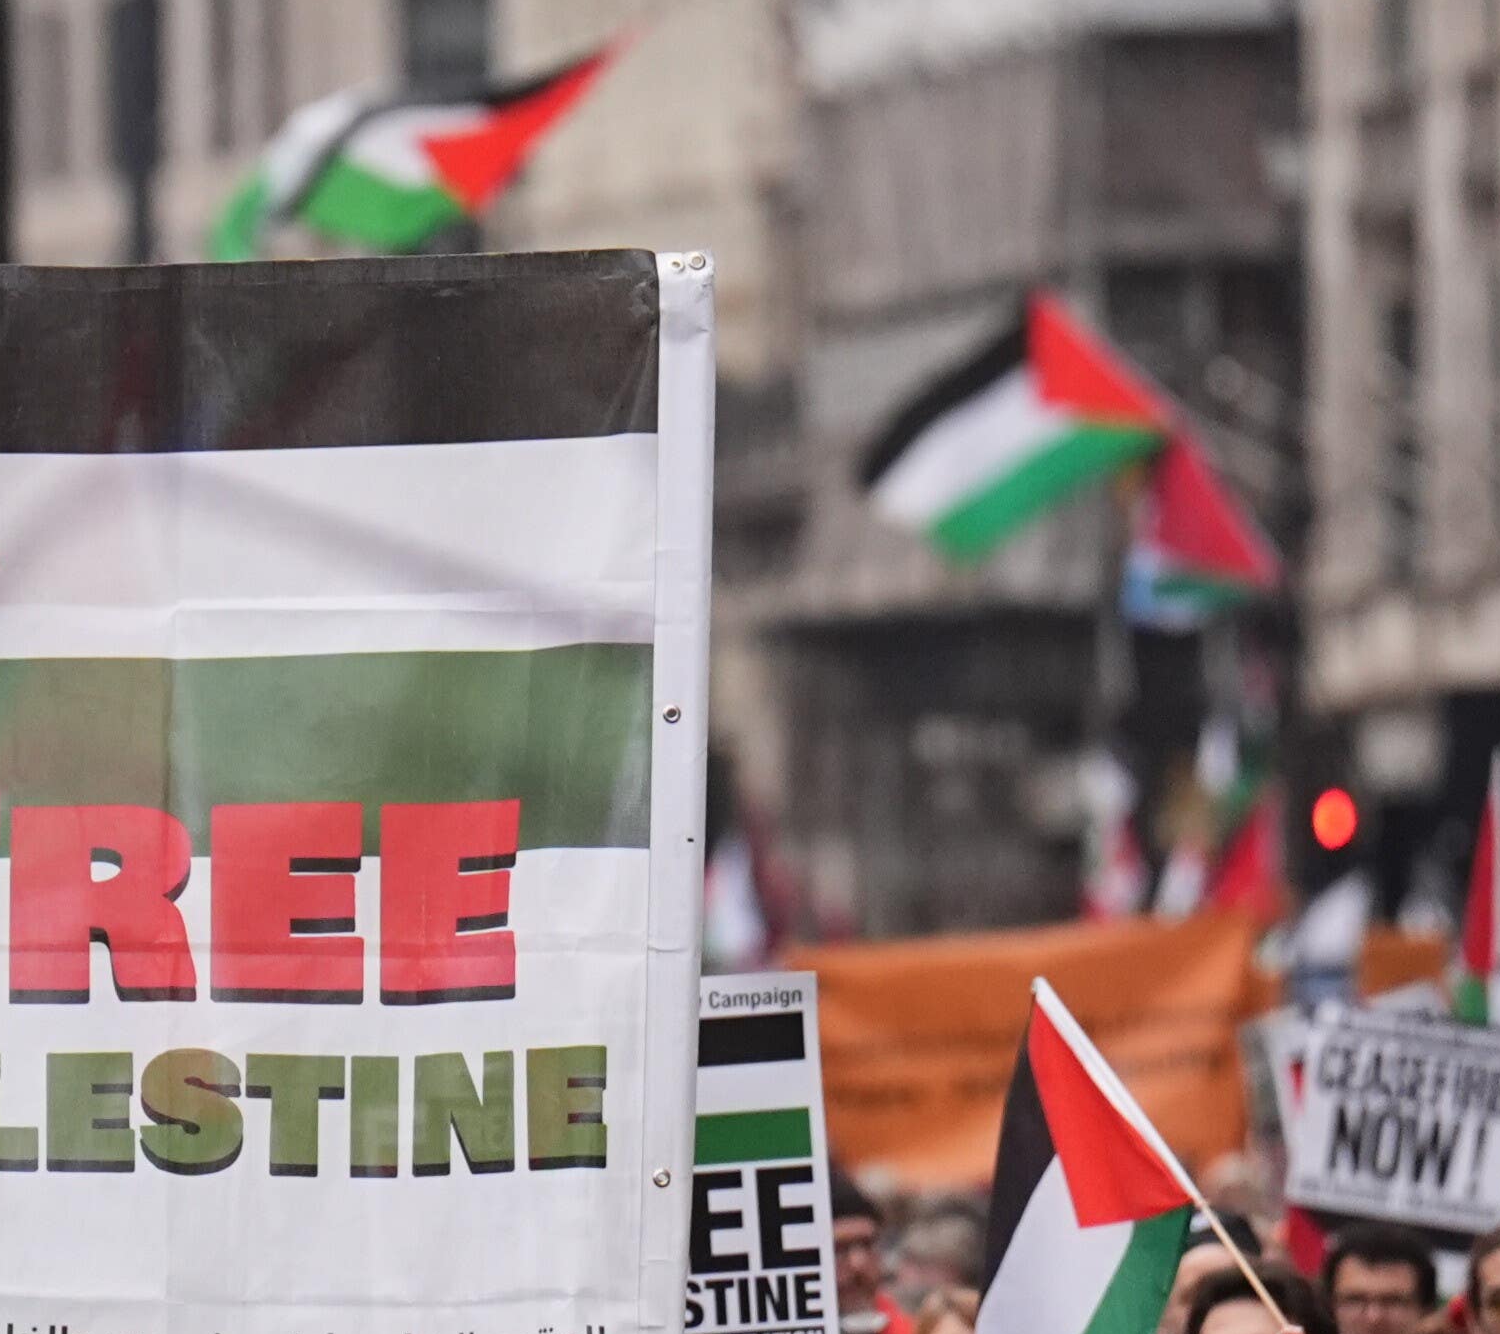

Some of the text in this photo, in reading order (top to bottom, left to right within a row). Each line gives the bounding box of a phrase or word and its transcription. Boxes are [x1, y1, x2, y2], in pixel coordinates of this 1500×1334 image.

[708, 987, 803, 1009] Campaign
[1328, 1106, 1488, 1196] NOW!
[689, 1165, 821, 1274] EE
[684, 1272, 824, 1329] STINE
